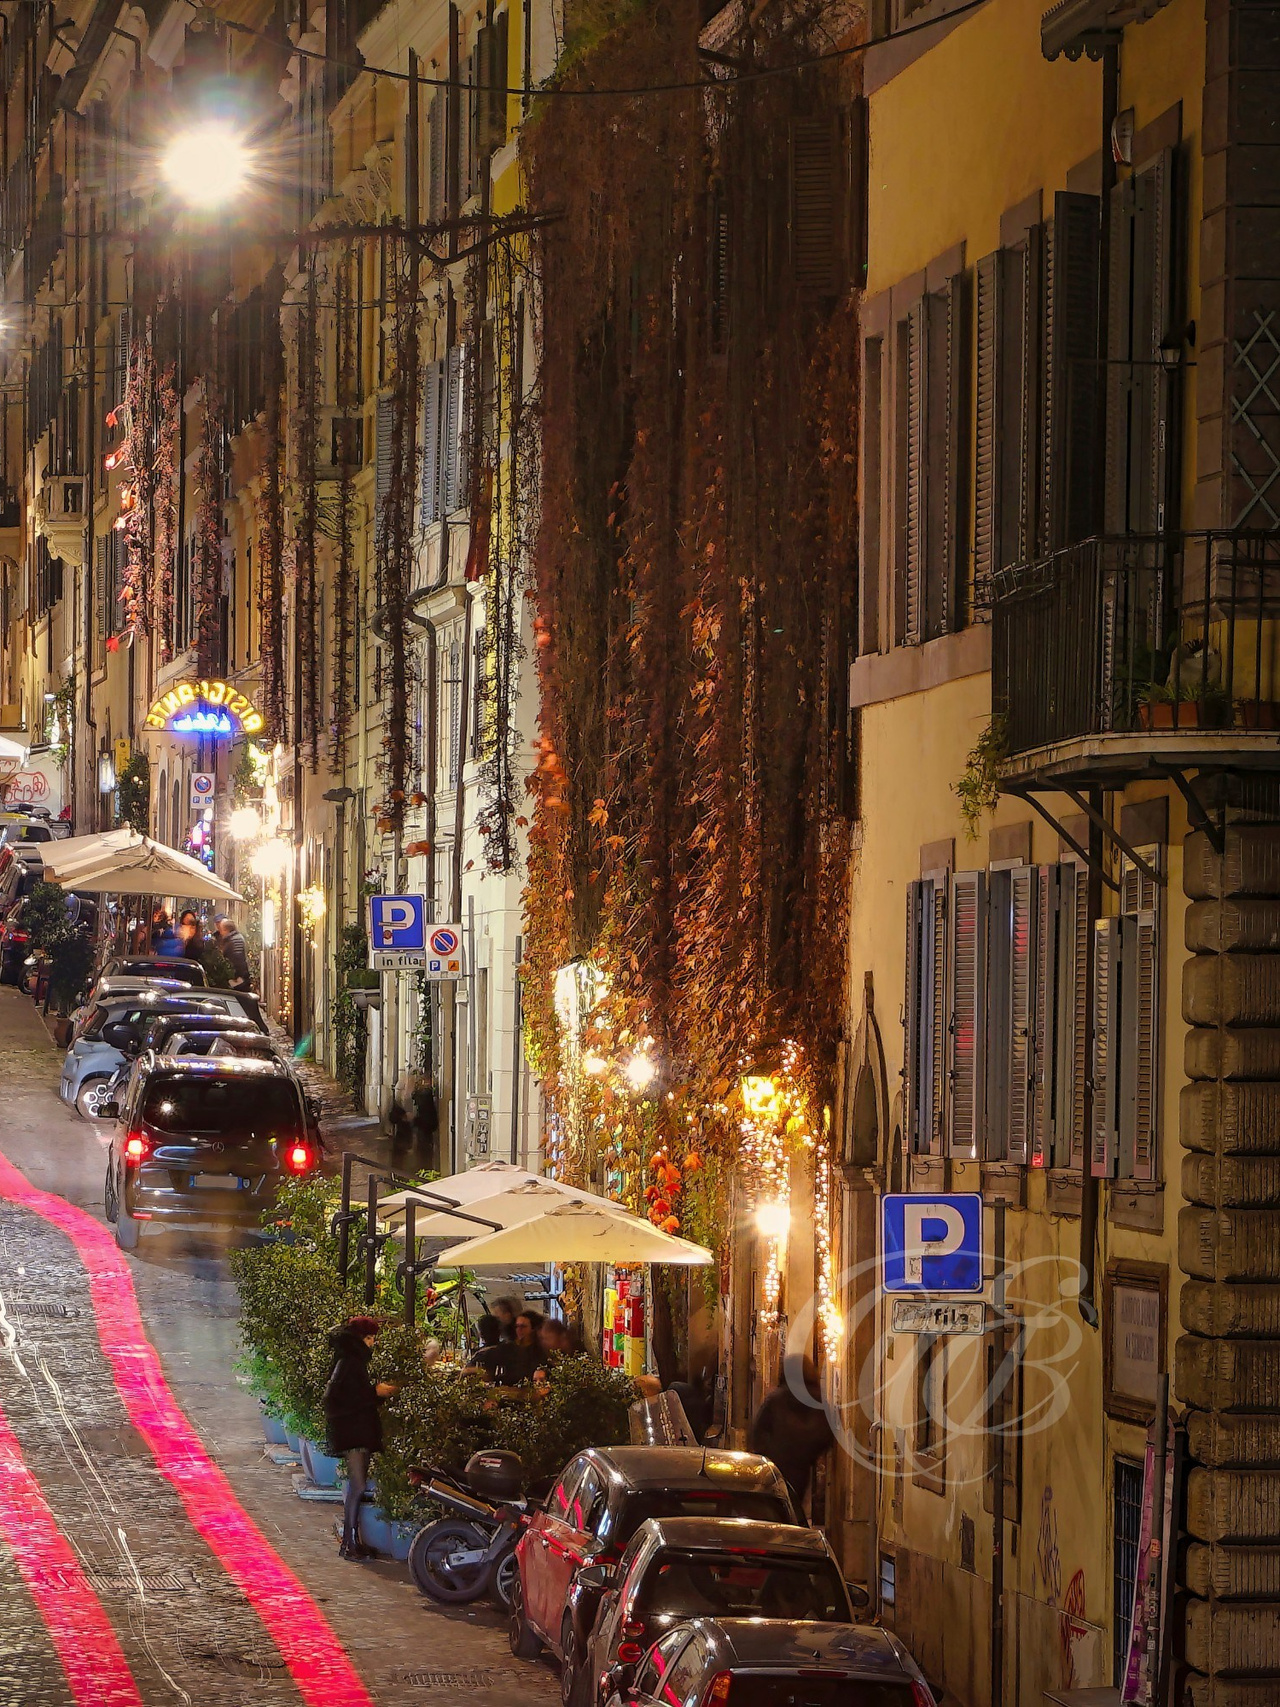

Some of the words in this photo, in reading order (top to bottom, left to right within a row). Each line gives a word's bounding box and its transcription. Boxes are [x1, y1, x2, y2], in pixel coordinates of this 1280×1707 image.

[382, 900, 415, 945] P
[382, 957, 393, 966] in
[398, 956, 419, 966] fila
[904, 1204, 965, 1284] P
